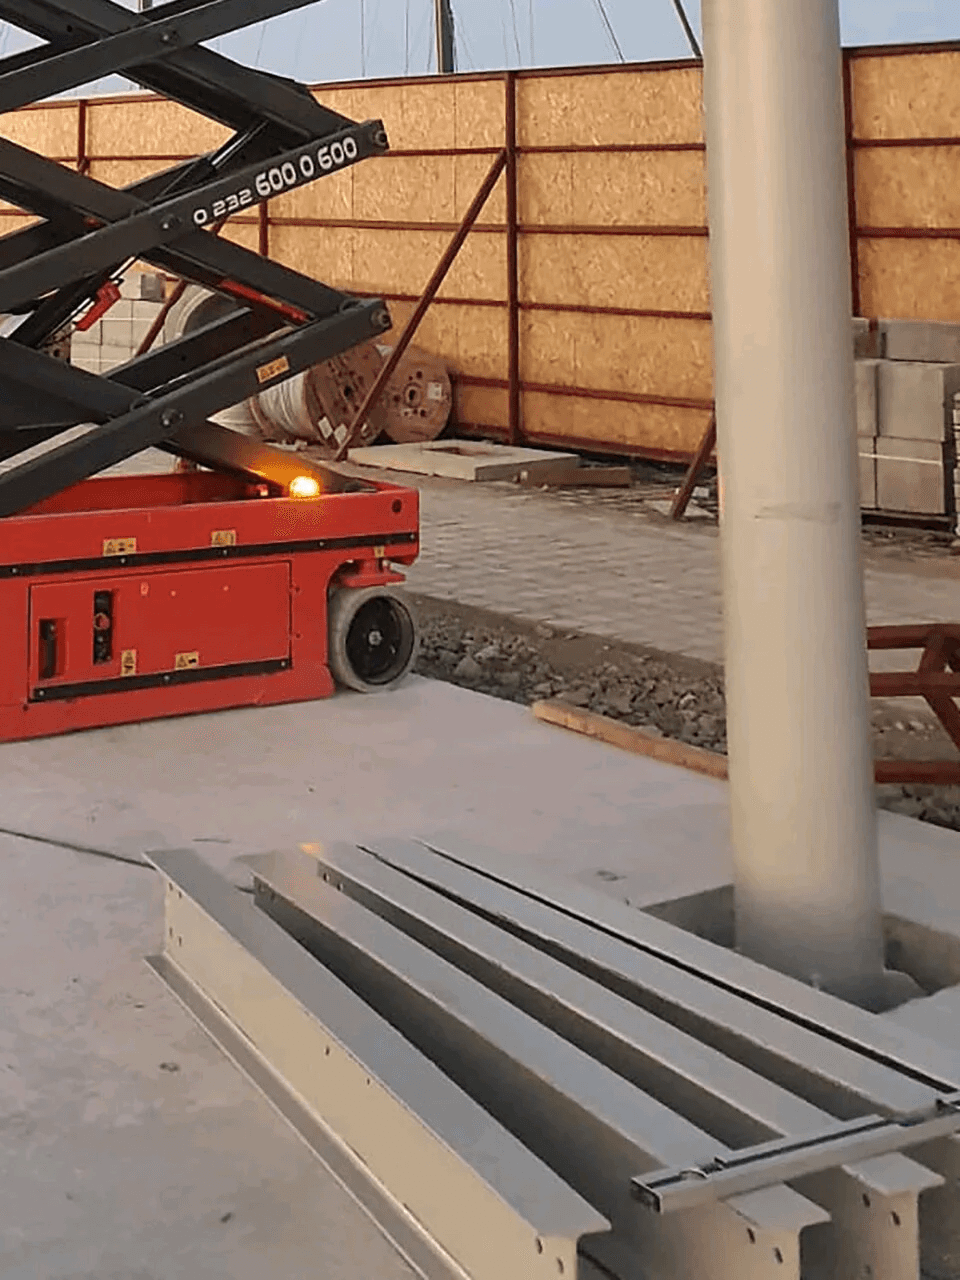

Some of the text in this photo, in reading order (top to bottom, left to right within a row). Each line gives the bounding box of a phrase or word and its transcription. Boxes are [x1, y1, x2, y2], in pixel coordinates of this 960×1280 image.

[193, 136, 358, 225] 0 232 600 0 600
